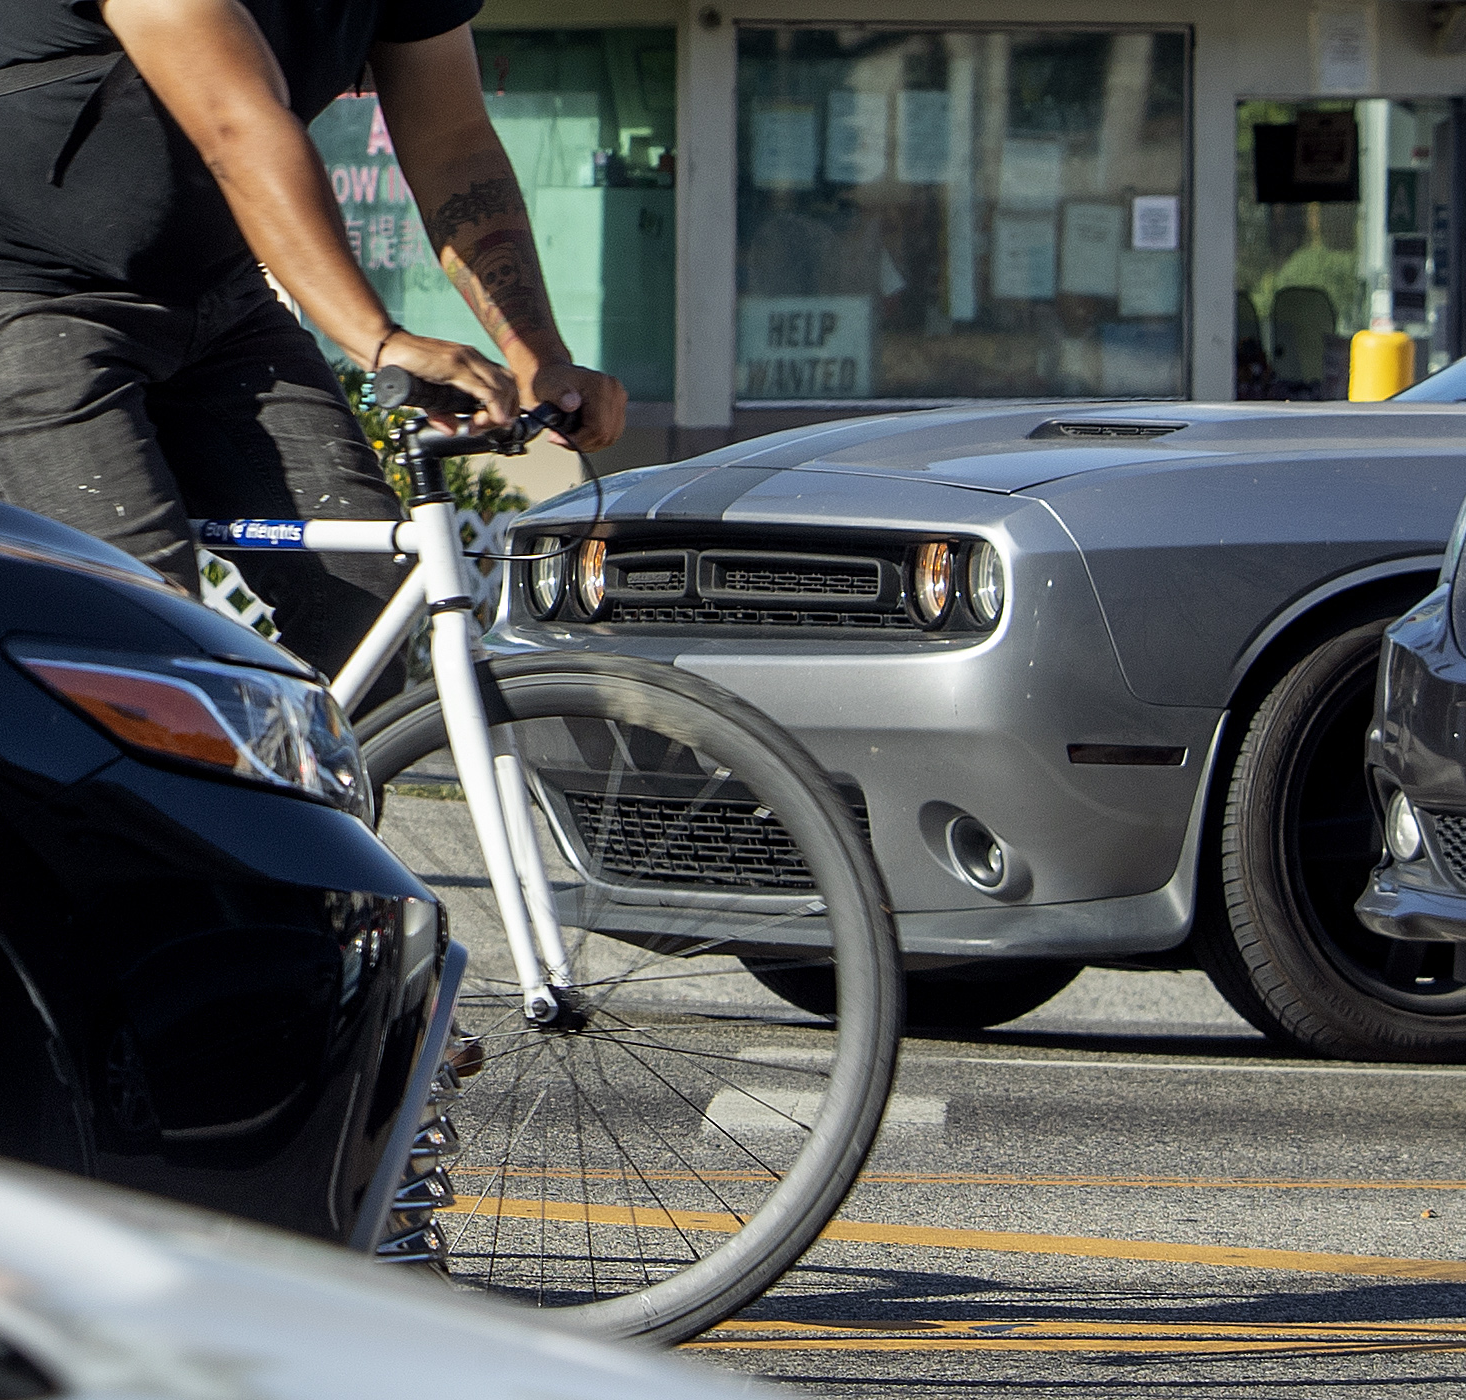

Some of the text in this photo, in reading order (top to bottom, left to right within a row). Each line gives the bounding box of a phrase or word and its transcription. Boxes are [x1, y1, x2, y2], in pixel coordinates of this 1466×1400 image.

[331, 165, 379, 204] OW
[767, 311, 837, 348] HELP
[747, 357, 857, 394] WANTED
